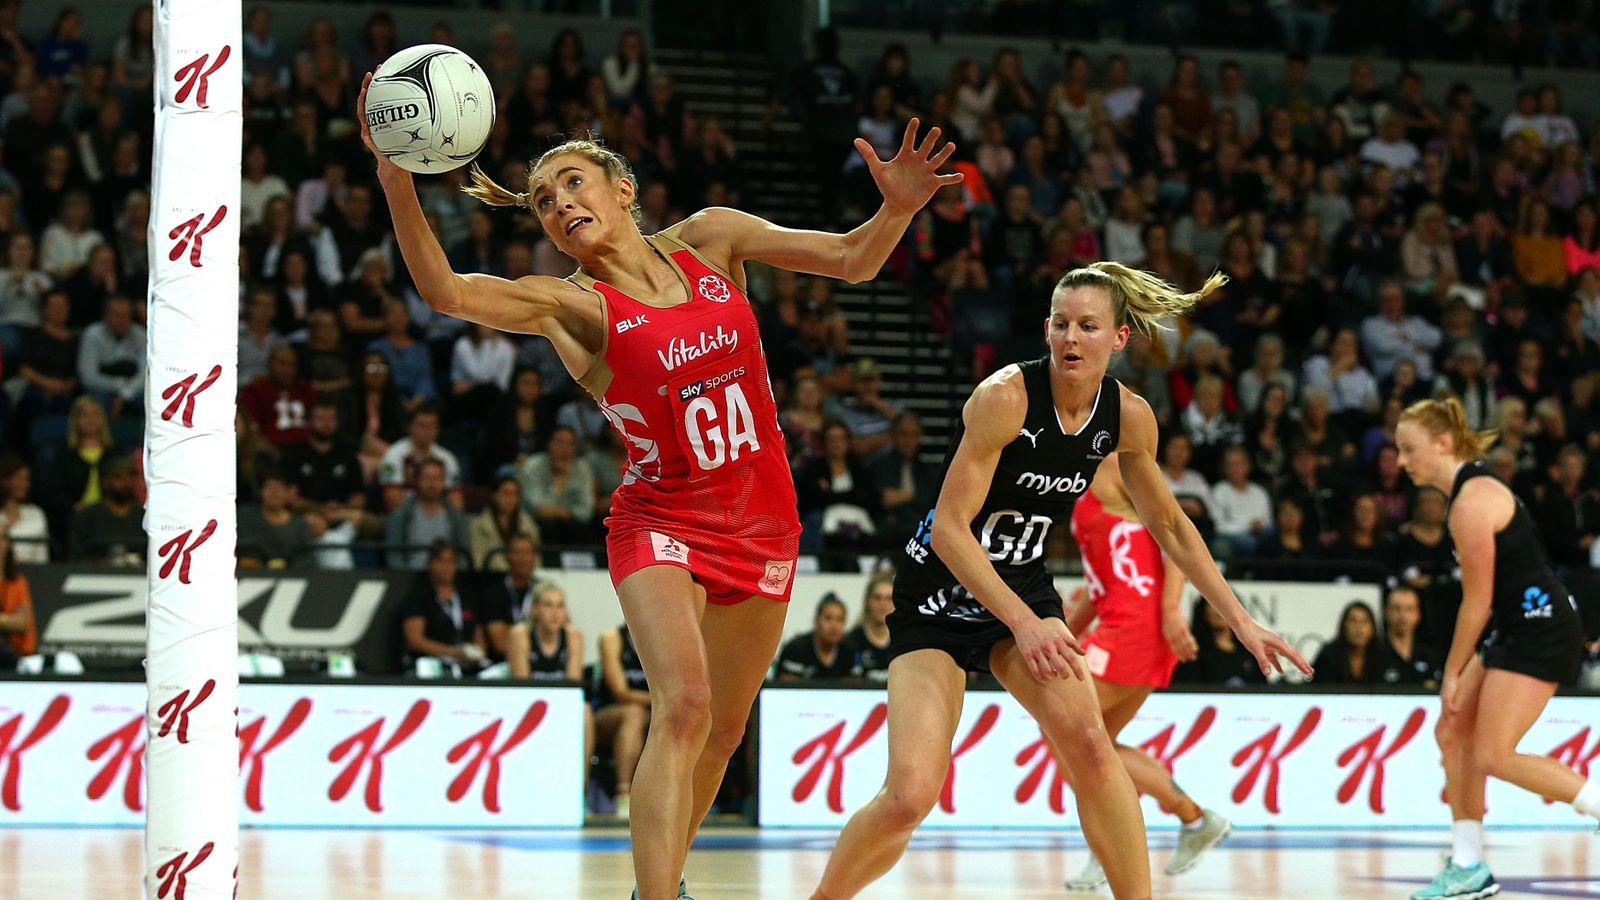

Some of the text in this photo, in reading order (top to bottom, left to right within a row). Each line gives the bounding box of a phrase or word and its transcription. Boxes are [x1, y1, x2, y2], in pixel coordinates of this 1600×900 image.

[615, 314, 651, 334] BLK
[657, 325, 738, 372] Vitality
[681, 366, 745, 399] sky sports
[685, 382, 761, 470] GA
[1016, 472, 1087, 495] myob
[981, 509, 1053, 566] GD
